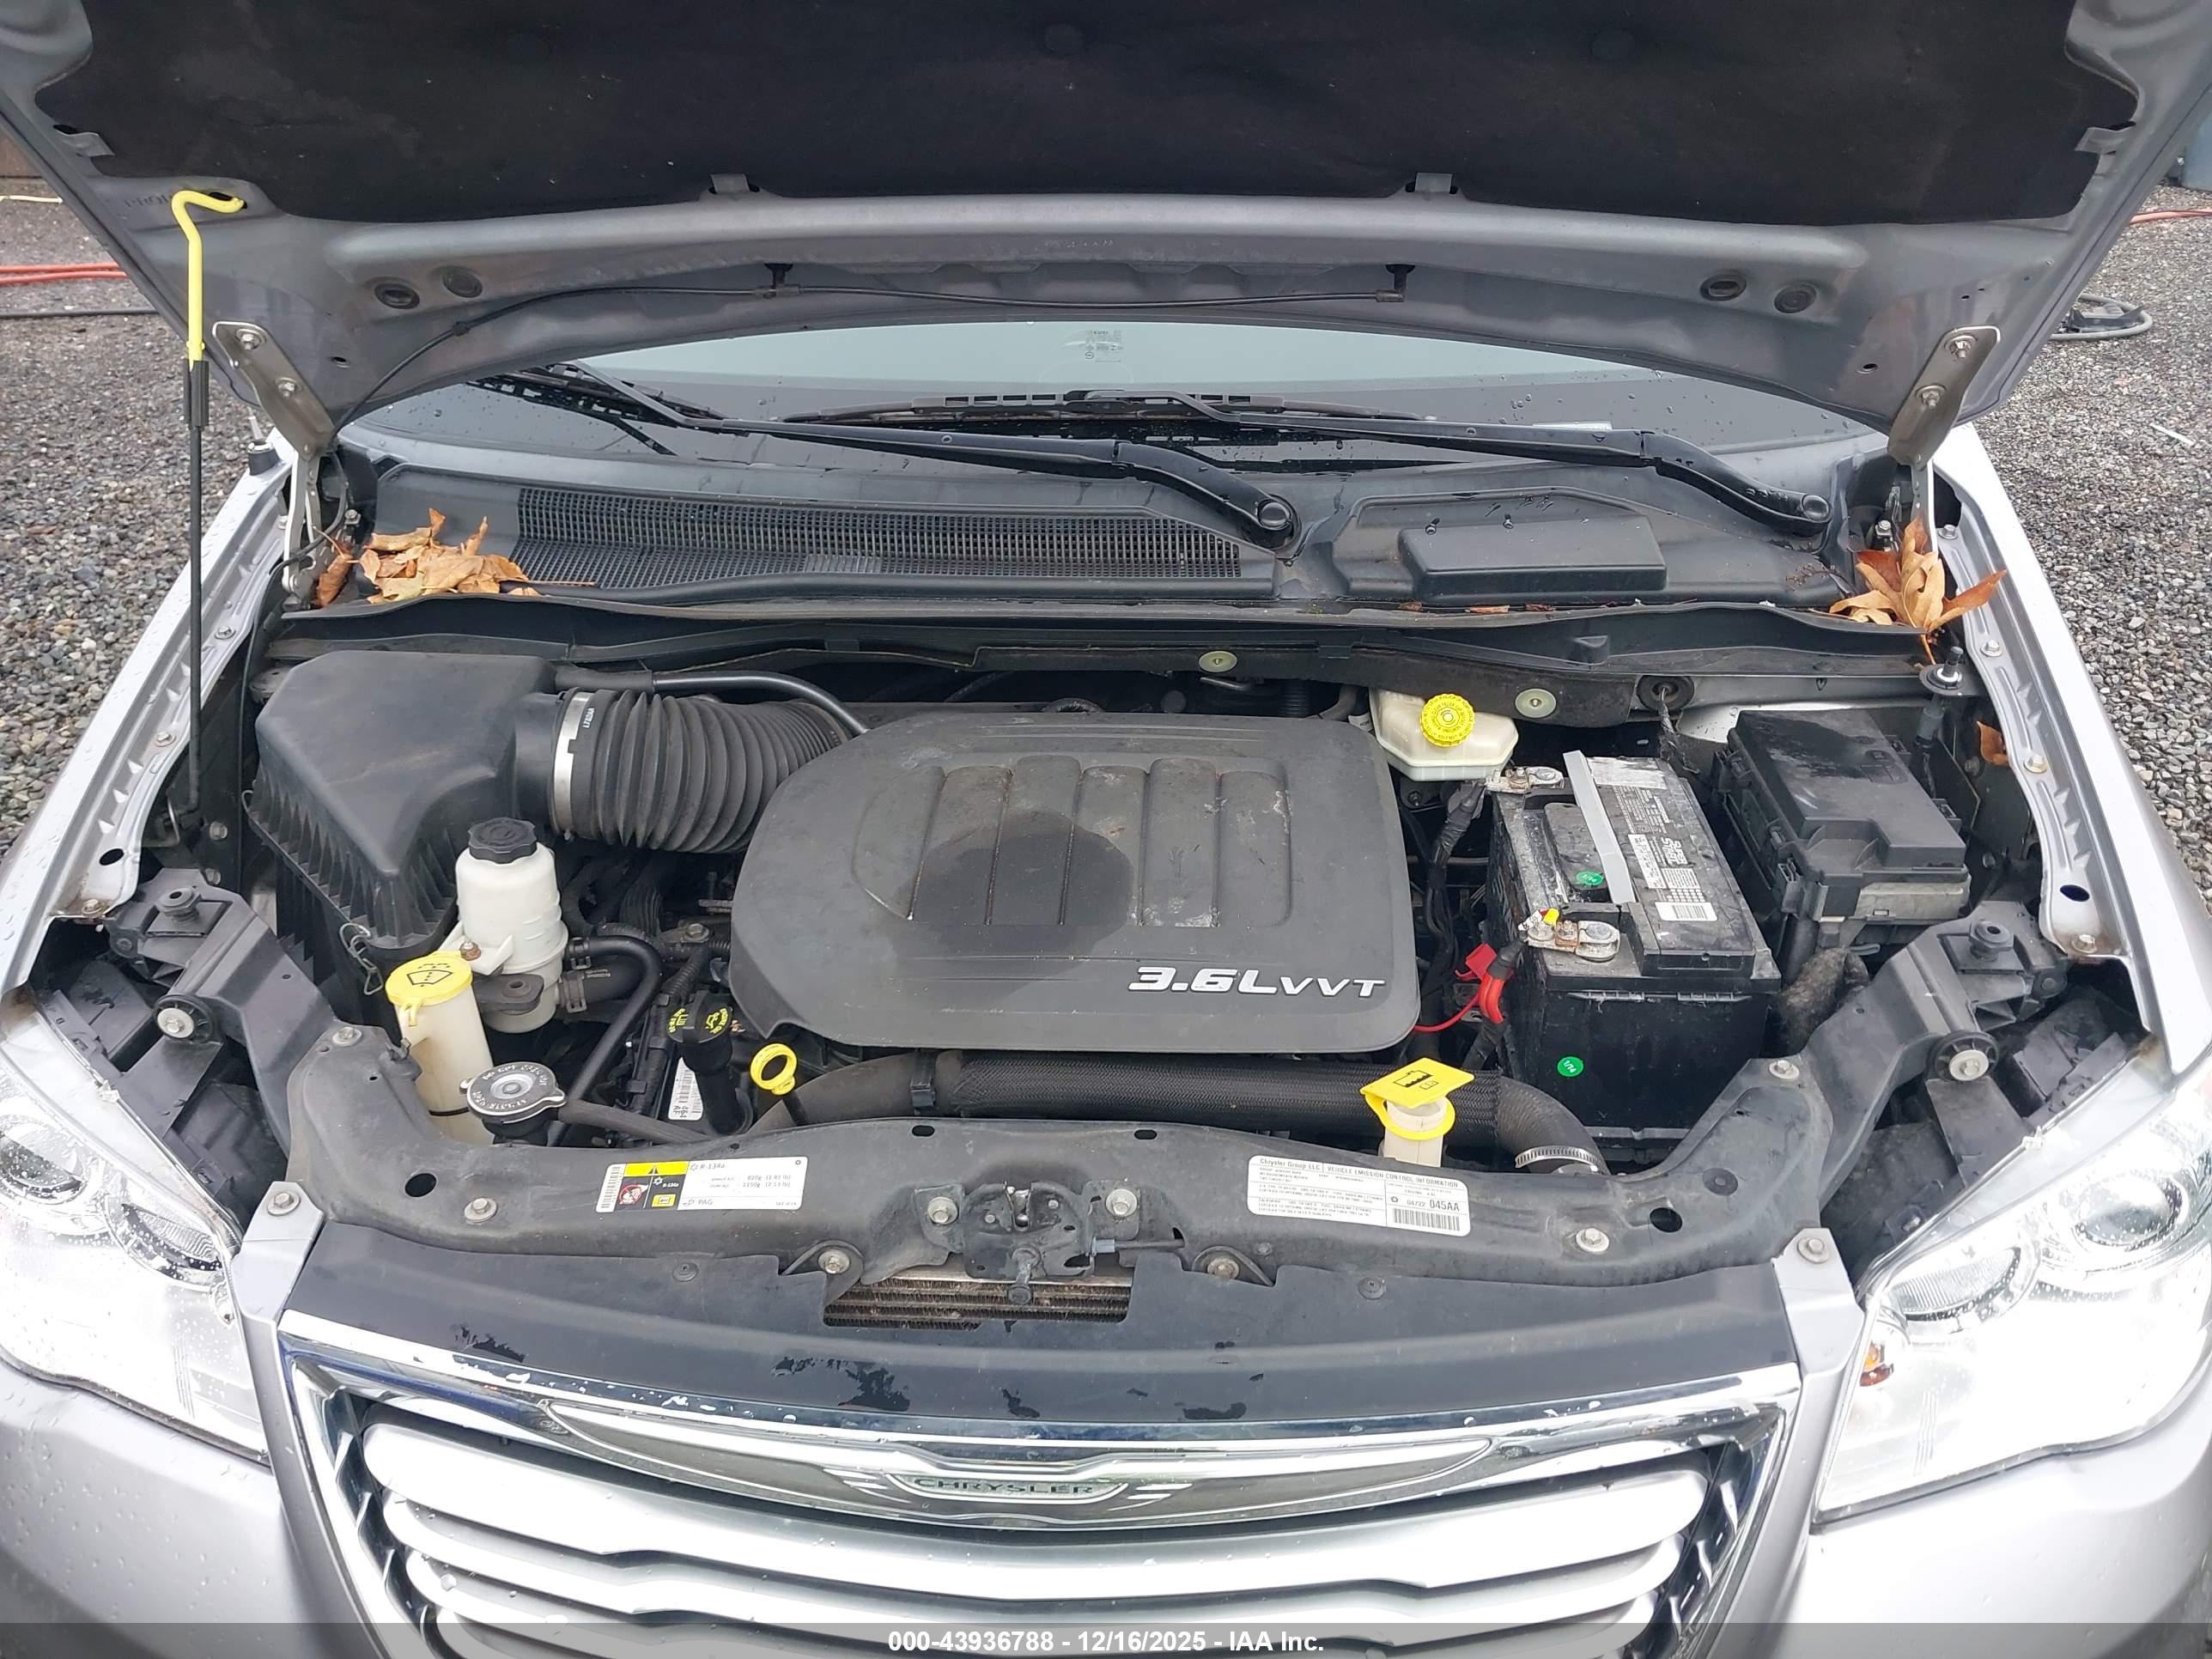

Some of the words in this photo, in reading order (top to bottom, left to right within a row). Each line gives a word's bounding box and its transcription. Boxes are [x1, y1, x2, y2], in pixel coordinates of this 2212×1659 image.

[1260, 1158, 1285, 1167] Chrysler
[1287, 1161, 1306, 1170] Group
[1328, 1166, 1352, 1175] VEHICLE
[1354, 1169, 1384, 1178] EMISSION
[1385, 1173, 1414, 1182] CONTROL
[1416, 1176, 1458, 1188] INFORMATION
[1429, 1199, 1460, 1212] 045AA
[914, 1478, 1094, 1494] CHRYSLER
